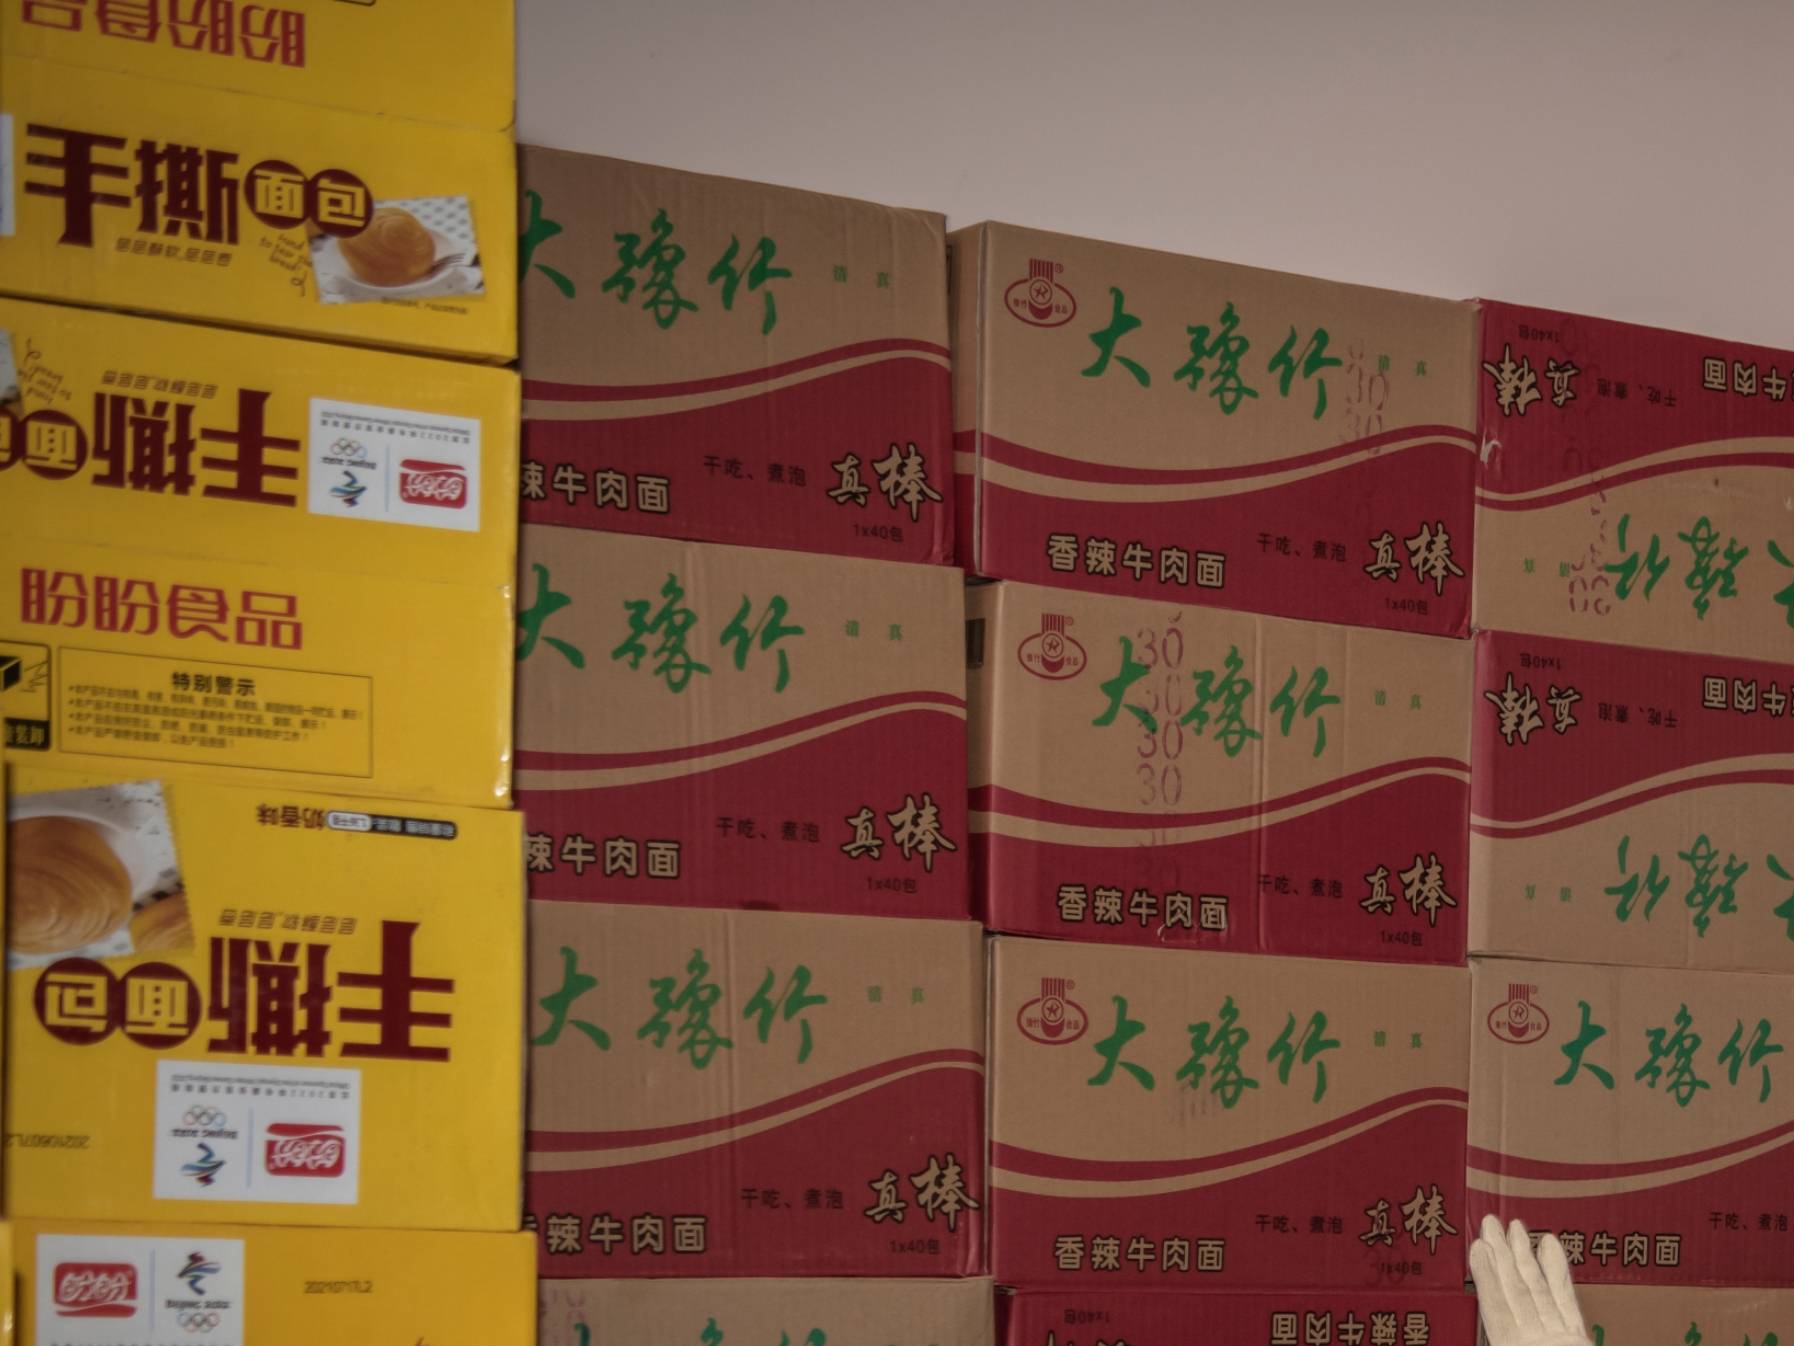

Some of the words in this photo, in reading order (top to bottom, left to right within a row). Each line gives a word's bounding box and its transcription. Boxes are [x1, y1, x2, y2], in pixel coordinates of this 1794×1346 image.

[24, 123, 374, 248] 手撕面包
[0, 388, 300, 508] 手撕面
[828, 443, 944, 522] 真棒
[1047, 532, 1227, 589] 香辣牛肉面
[1363, 521, 1466, 596] 真棒
[20, 567, 303, 650] 盼盼食品
[172, 672, 256, 697] 特别警示
[257, 804, 327, 831] 奶香味
[841, 793, 957, 873] 真棒
[1057, 884, 1229, 932] 香辣牛肉面
[1360, 852, 1458, 928] 真棒
[35, 920, 455, 1061] 手撕面包
[864, 1152, 983, 1232] 真棒
[1360, 1184, 1459, 1256] 真棒
[1054, 1235, 1226, 1273] 香辣牛肉面
[1270, 1311, 1430, 1346] 香辣牛肉面
